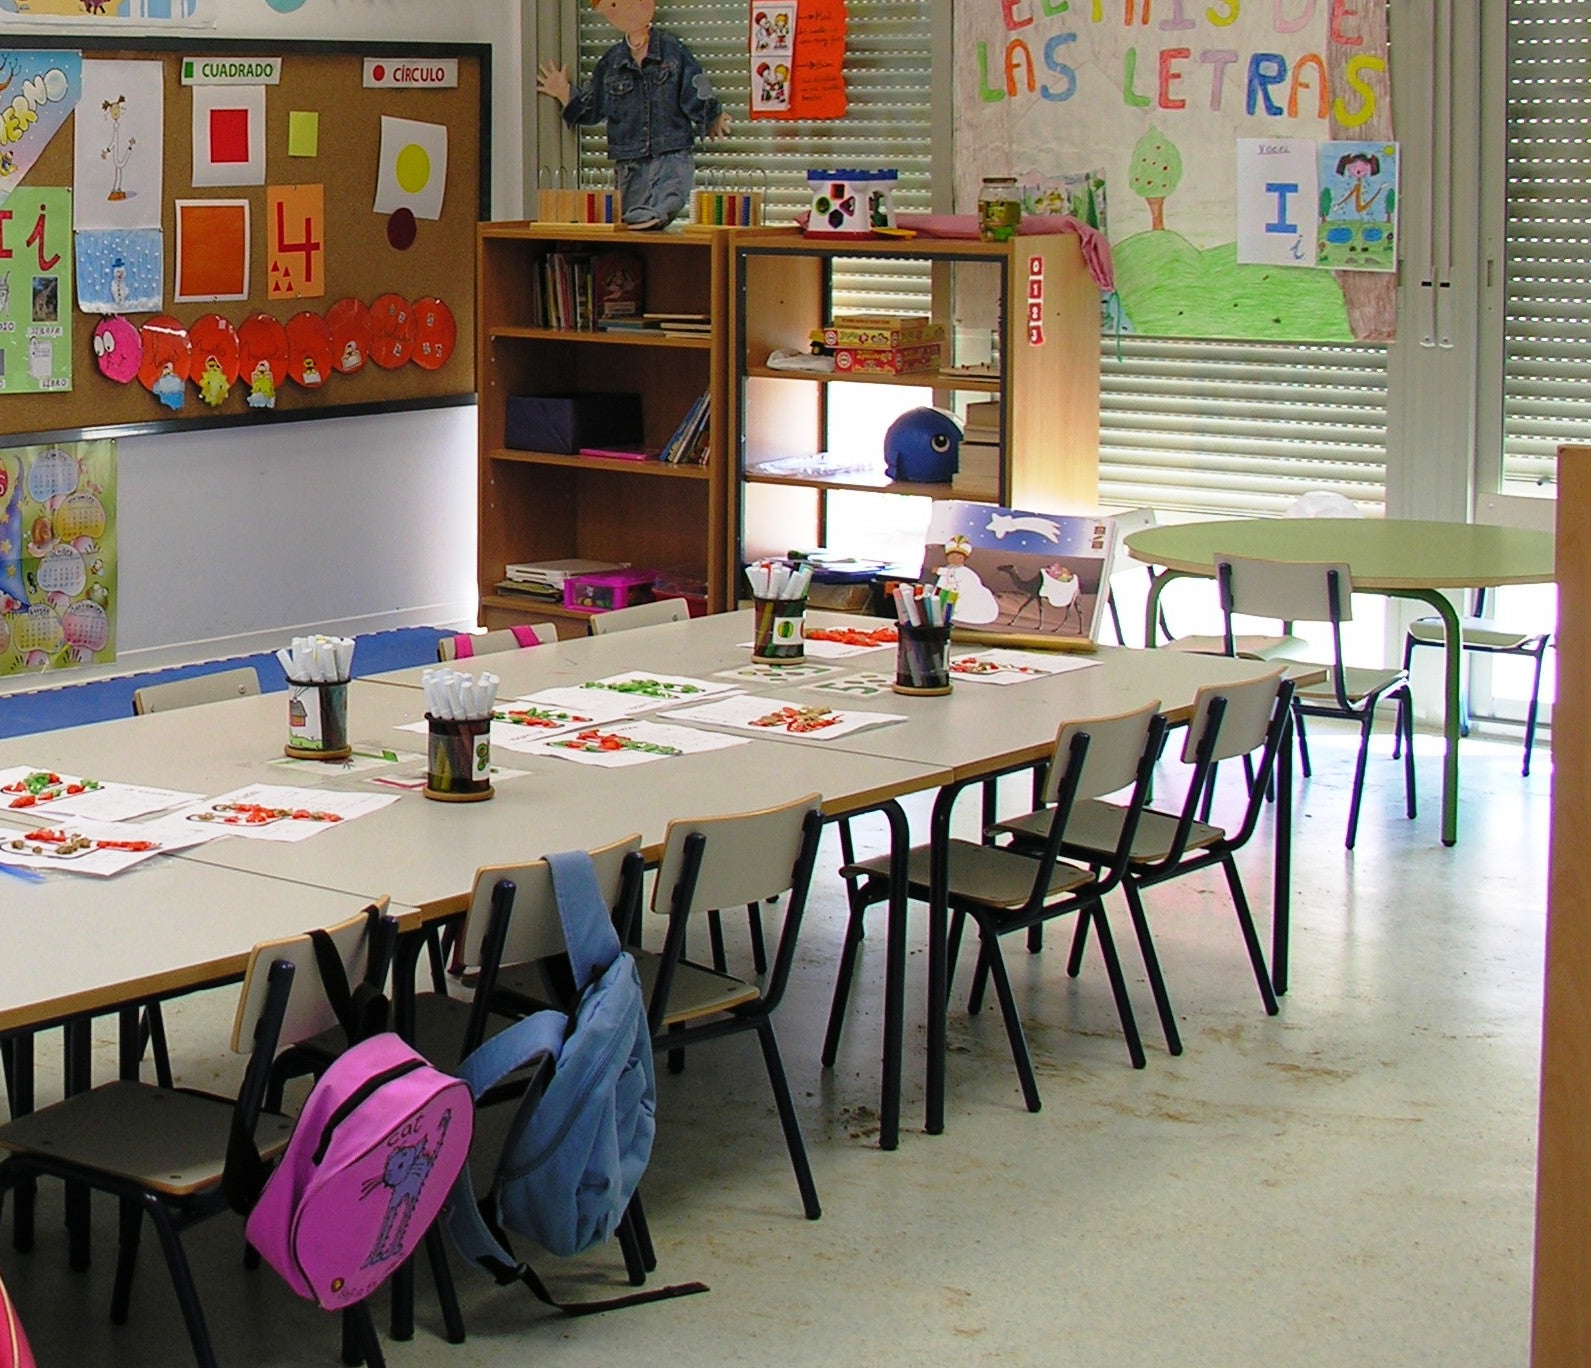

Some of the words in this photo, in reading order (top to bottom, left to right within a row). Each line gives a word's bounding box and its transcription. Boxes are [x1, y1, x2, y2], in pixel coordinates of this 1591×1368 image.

[201, 63, 274, 78] CUADRADO
[392, 64, 446, 82] CÍRCULO
[976, 32, 1077, 103] LAS
[1123, 47, 1386, 129] LETRAS
[1265, 182, 1299, 233] I
[276, 201, 321, 283] 4
